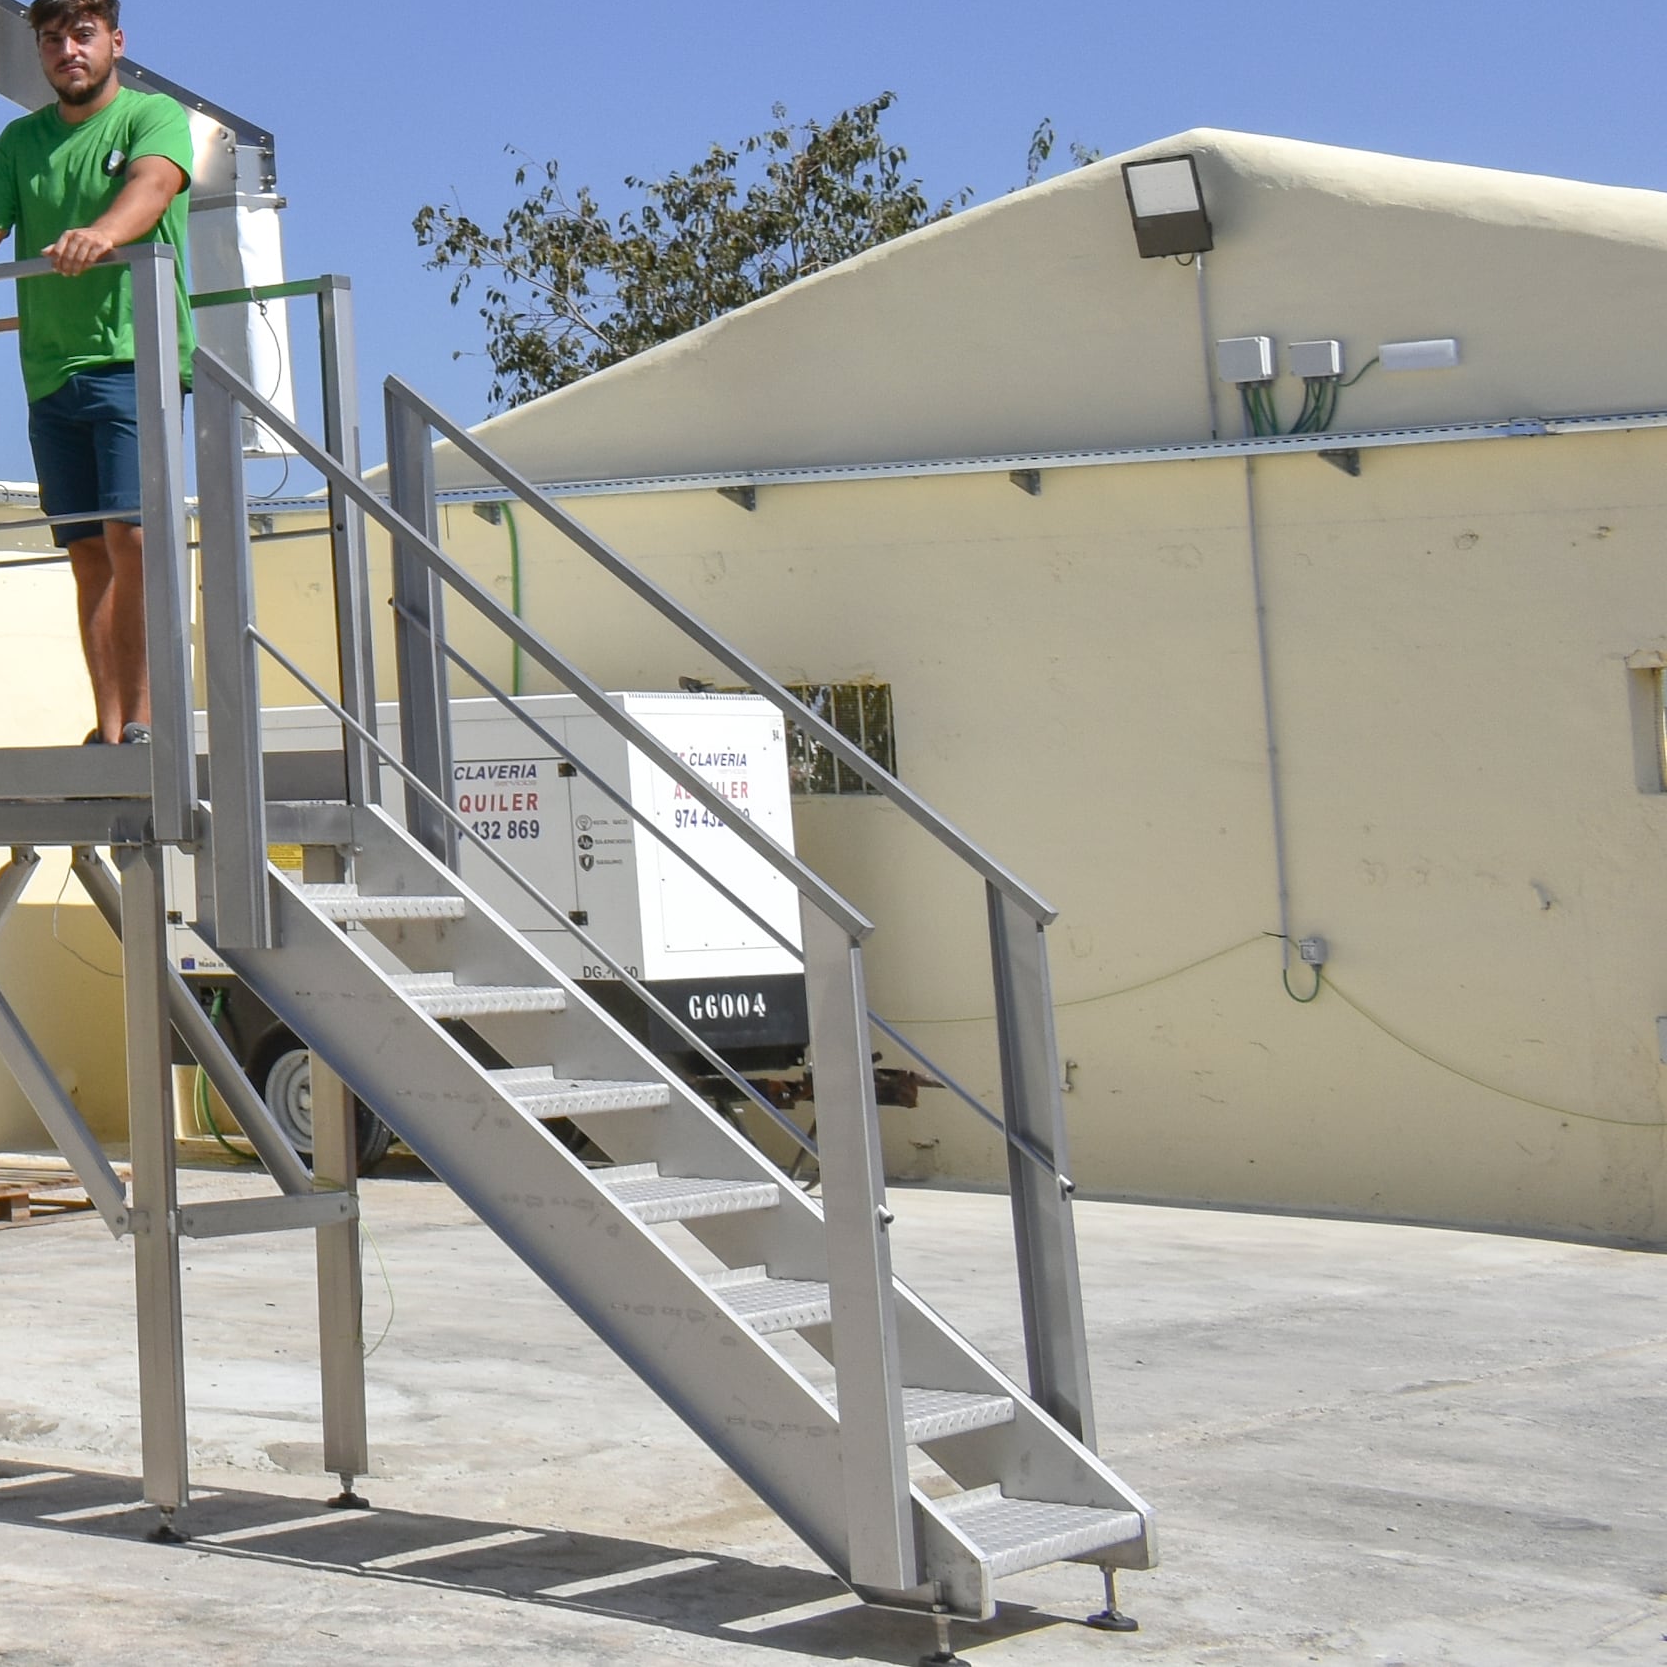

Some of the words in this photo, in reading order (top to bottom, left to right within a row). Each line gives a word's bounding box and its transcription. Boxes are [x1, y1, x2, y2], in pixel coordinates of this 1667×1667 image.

[689, 752, 747, 767] CLAVERIA
[454, 764, 537, 781] CLAVERIA
[675, 808, 698, 828] 974
[507, 819, 540, 840] 869
[688, 992, 766, 1020] G6004
